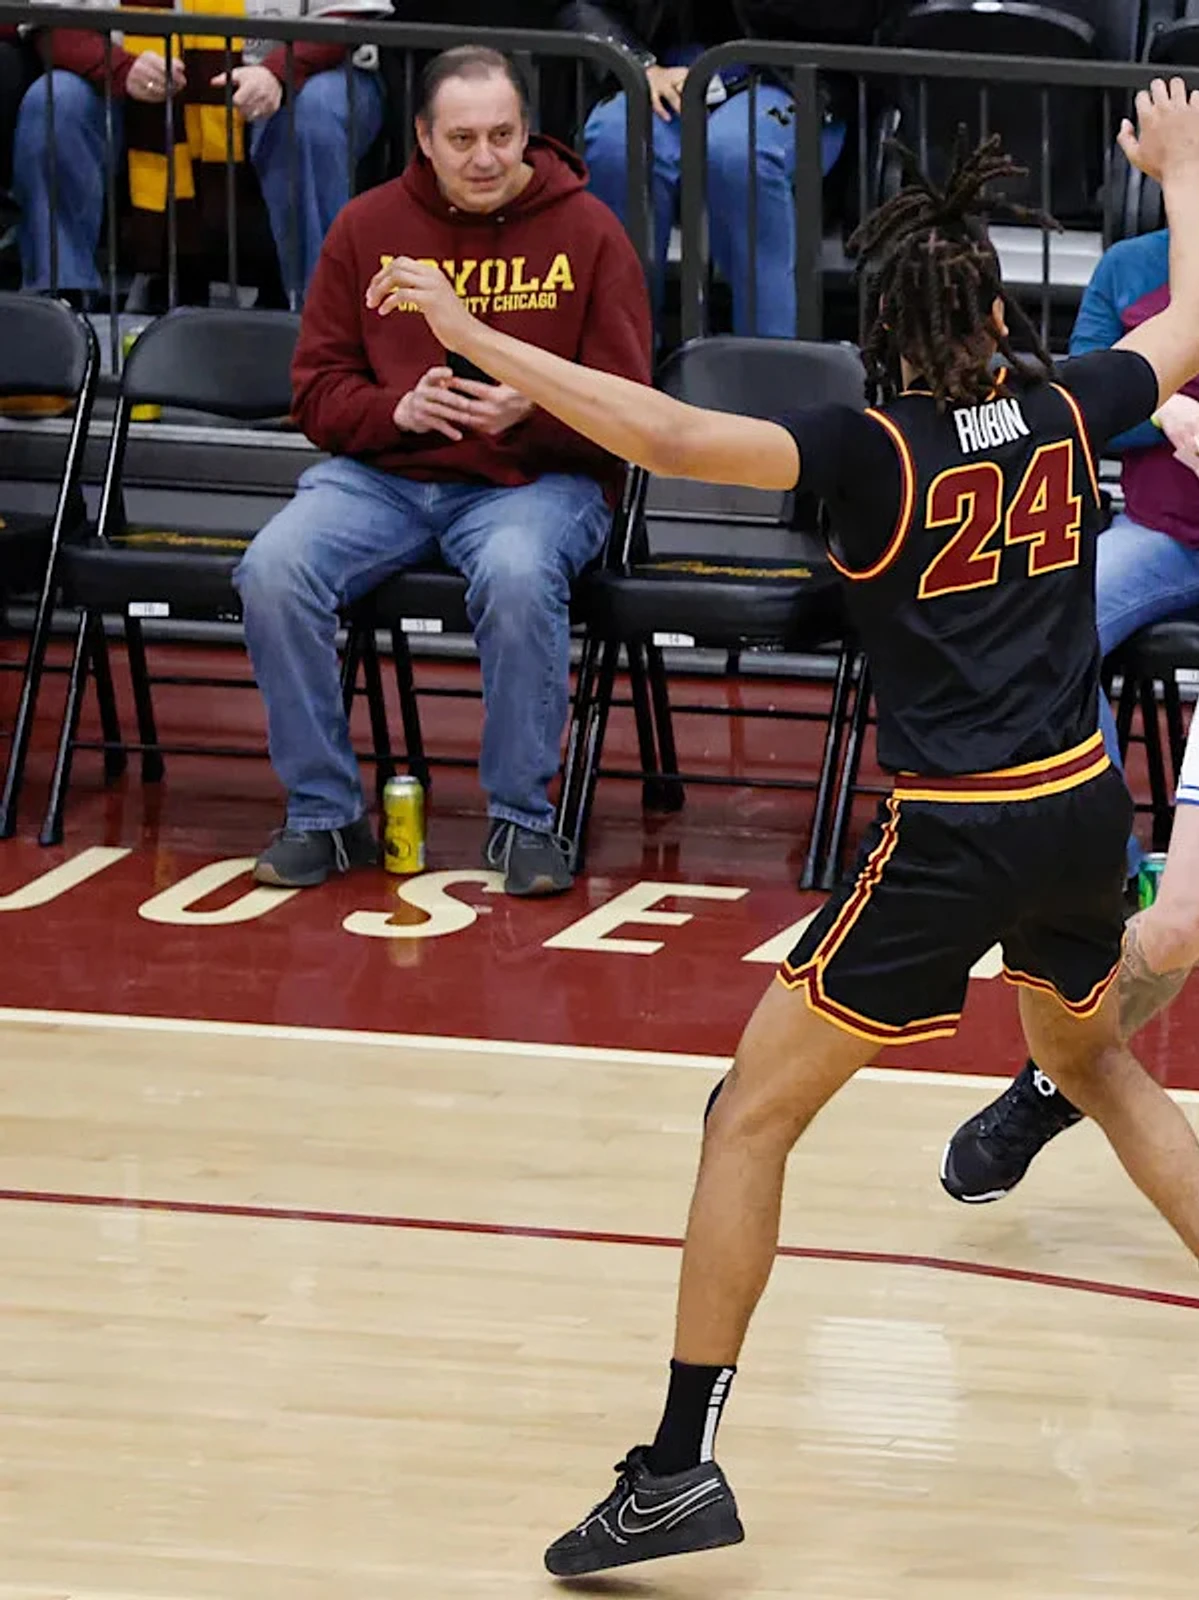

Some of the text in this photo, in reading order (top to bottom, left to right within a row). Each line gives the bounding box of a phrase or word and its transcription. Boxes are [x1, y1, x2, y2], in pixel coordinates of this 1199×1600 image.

[380, 253, 575, 298] YOLA
[493, 292, 557, 312] CHICAGO
[953, 398, 1030, 453] RUBIN
[917, 438, 1082, 599] 24
[0, 846, 1003, 979] JOSE
